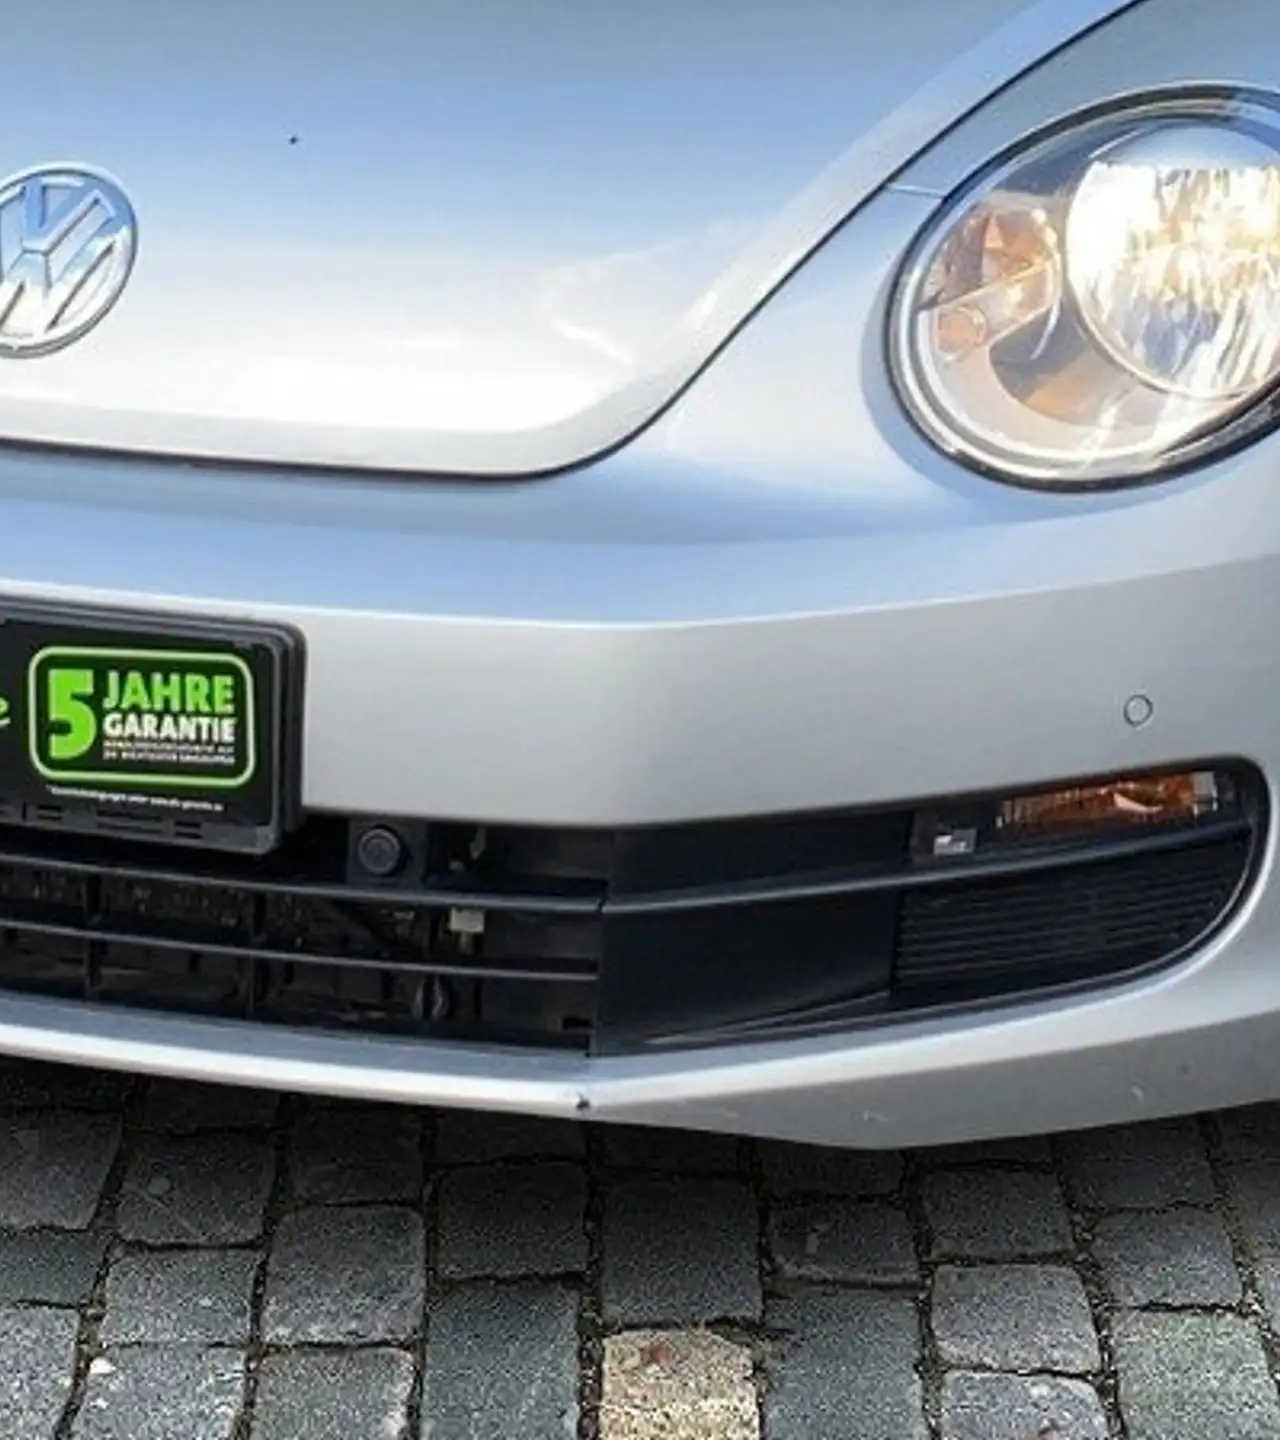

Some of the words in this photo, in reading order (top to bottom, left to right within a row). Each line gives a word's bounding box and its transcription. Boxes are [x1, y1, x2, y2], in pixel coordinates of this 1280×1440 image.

[48, 668, 97, 759] 5
[102, 670, 235, 715] JAHRE
[102, 712, 237, 744] GARANTIE
